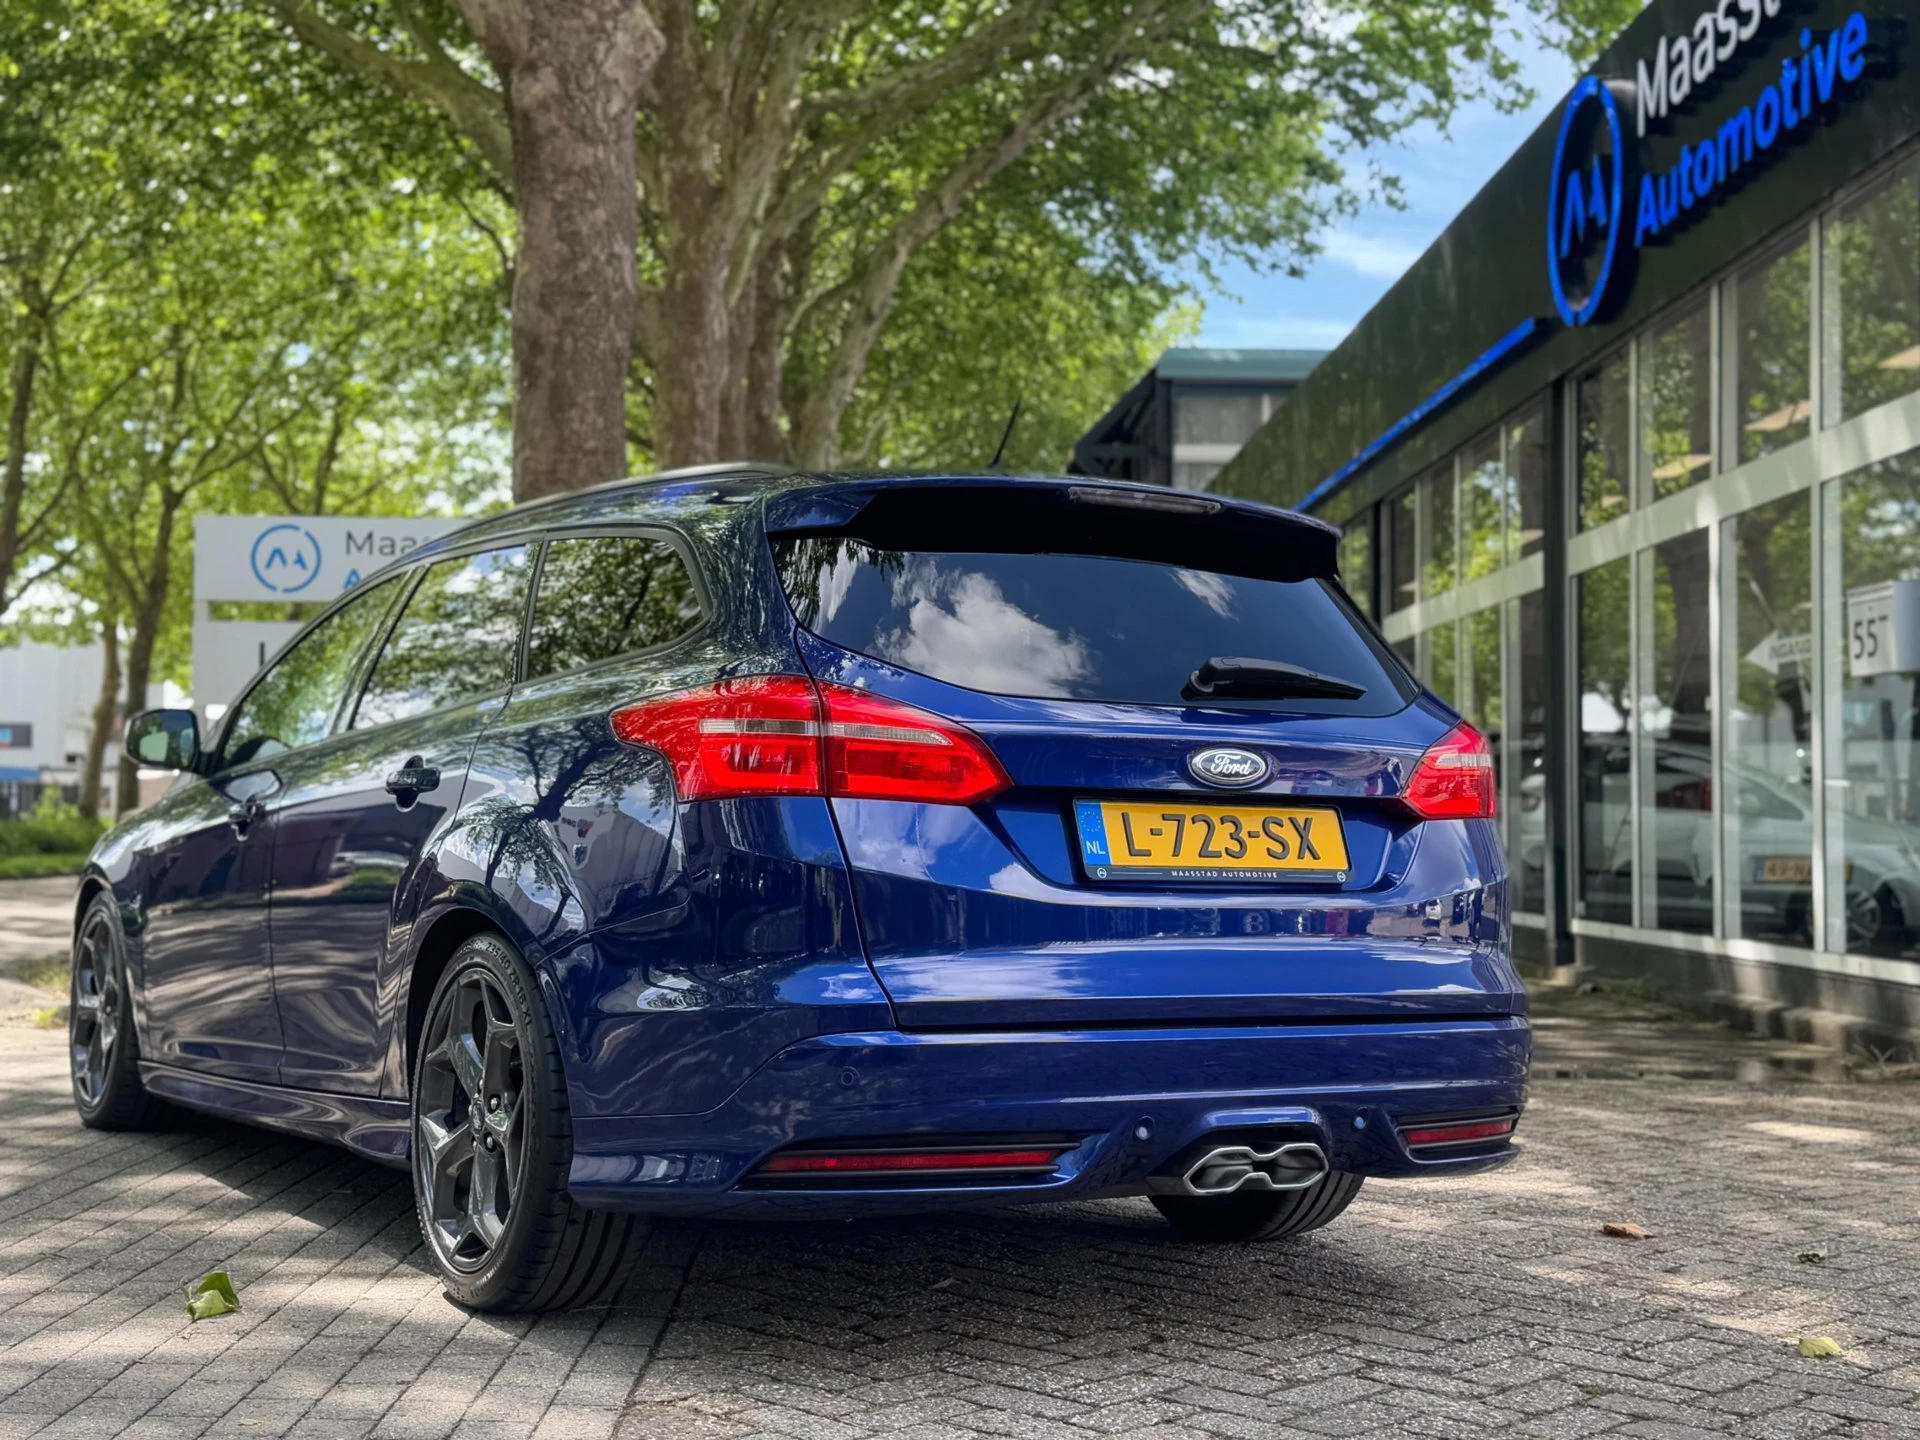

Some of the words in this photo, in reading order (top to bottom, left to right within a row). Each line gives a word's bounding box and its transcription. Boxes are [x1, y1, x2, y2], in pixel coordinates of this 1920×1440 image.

[1636, 0, 1782, 138] Maass
[1634, 11, 1868, 248] Automotive
[346, 530, 430, 557] Maa
[1210, 753, 1253, 776] Ford
[1086, 840, 1106, 855] NL
[1121, 811, 1322, 861] L-723-SX
[1222, 871, 1277, 879] AUTOMOTIVE
[486, 942, 511, 970] 235/40
